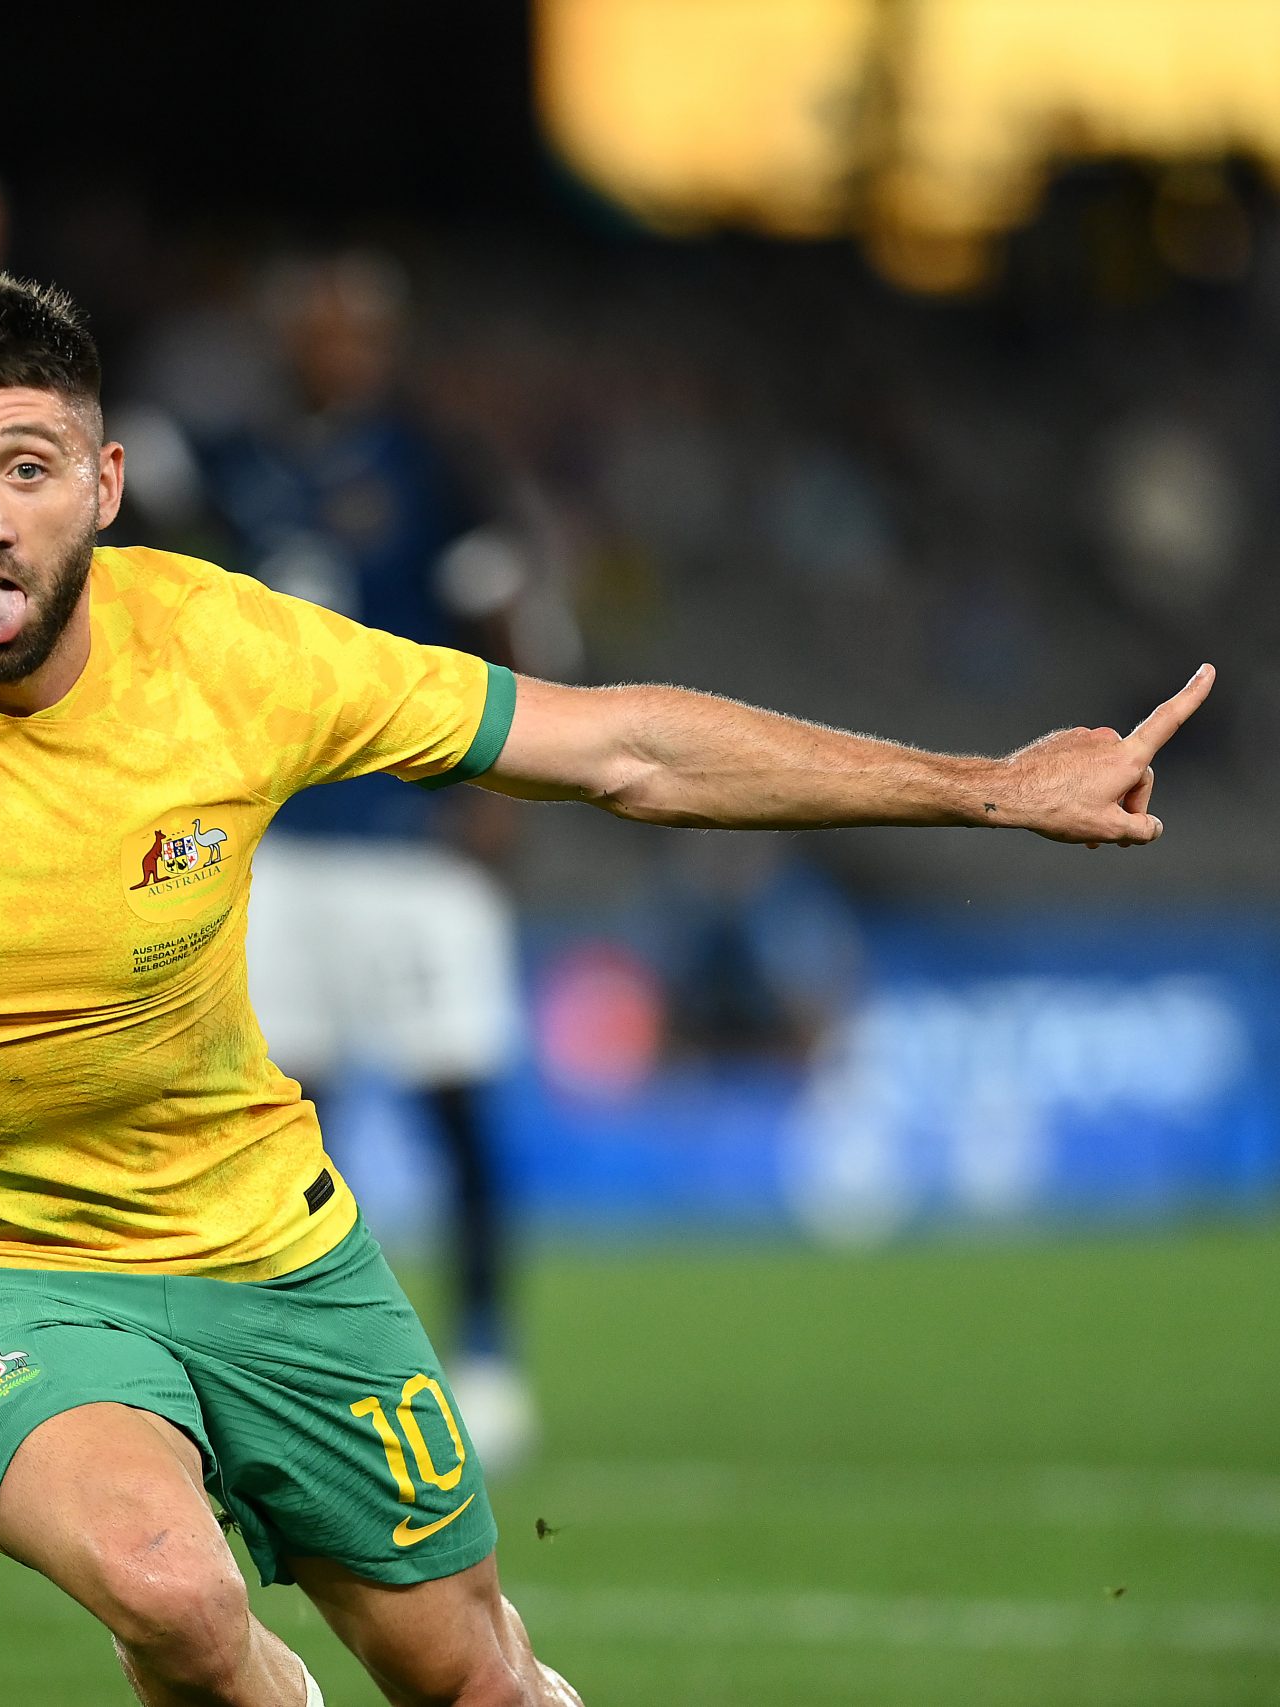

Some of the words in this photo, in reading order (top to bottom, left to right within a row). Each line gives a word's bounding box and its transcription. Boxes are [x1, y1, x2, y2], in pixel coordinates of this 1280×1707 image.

[147, 865, 221, 897] AUSTRALIA
[133, 937, 185, 955] AUSTRALIA
[134, 947, 177, 965] TUESDAY
[349, 1373, 466, 1503] 10
